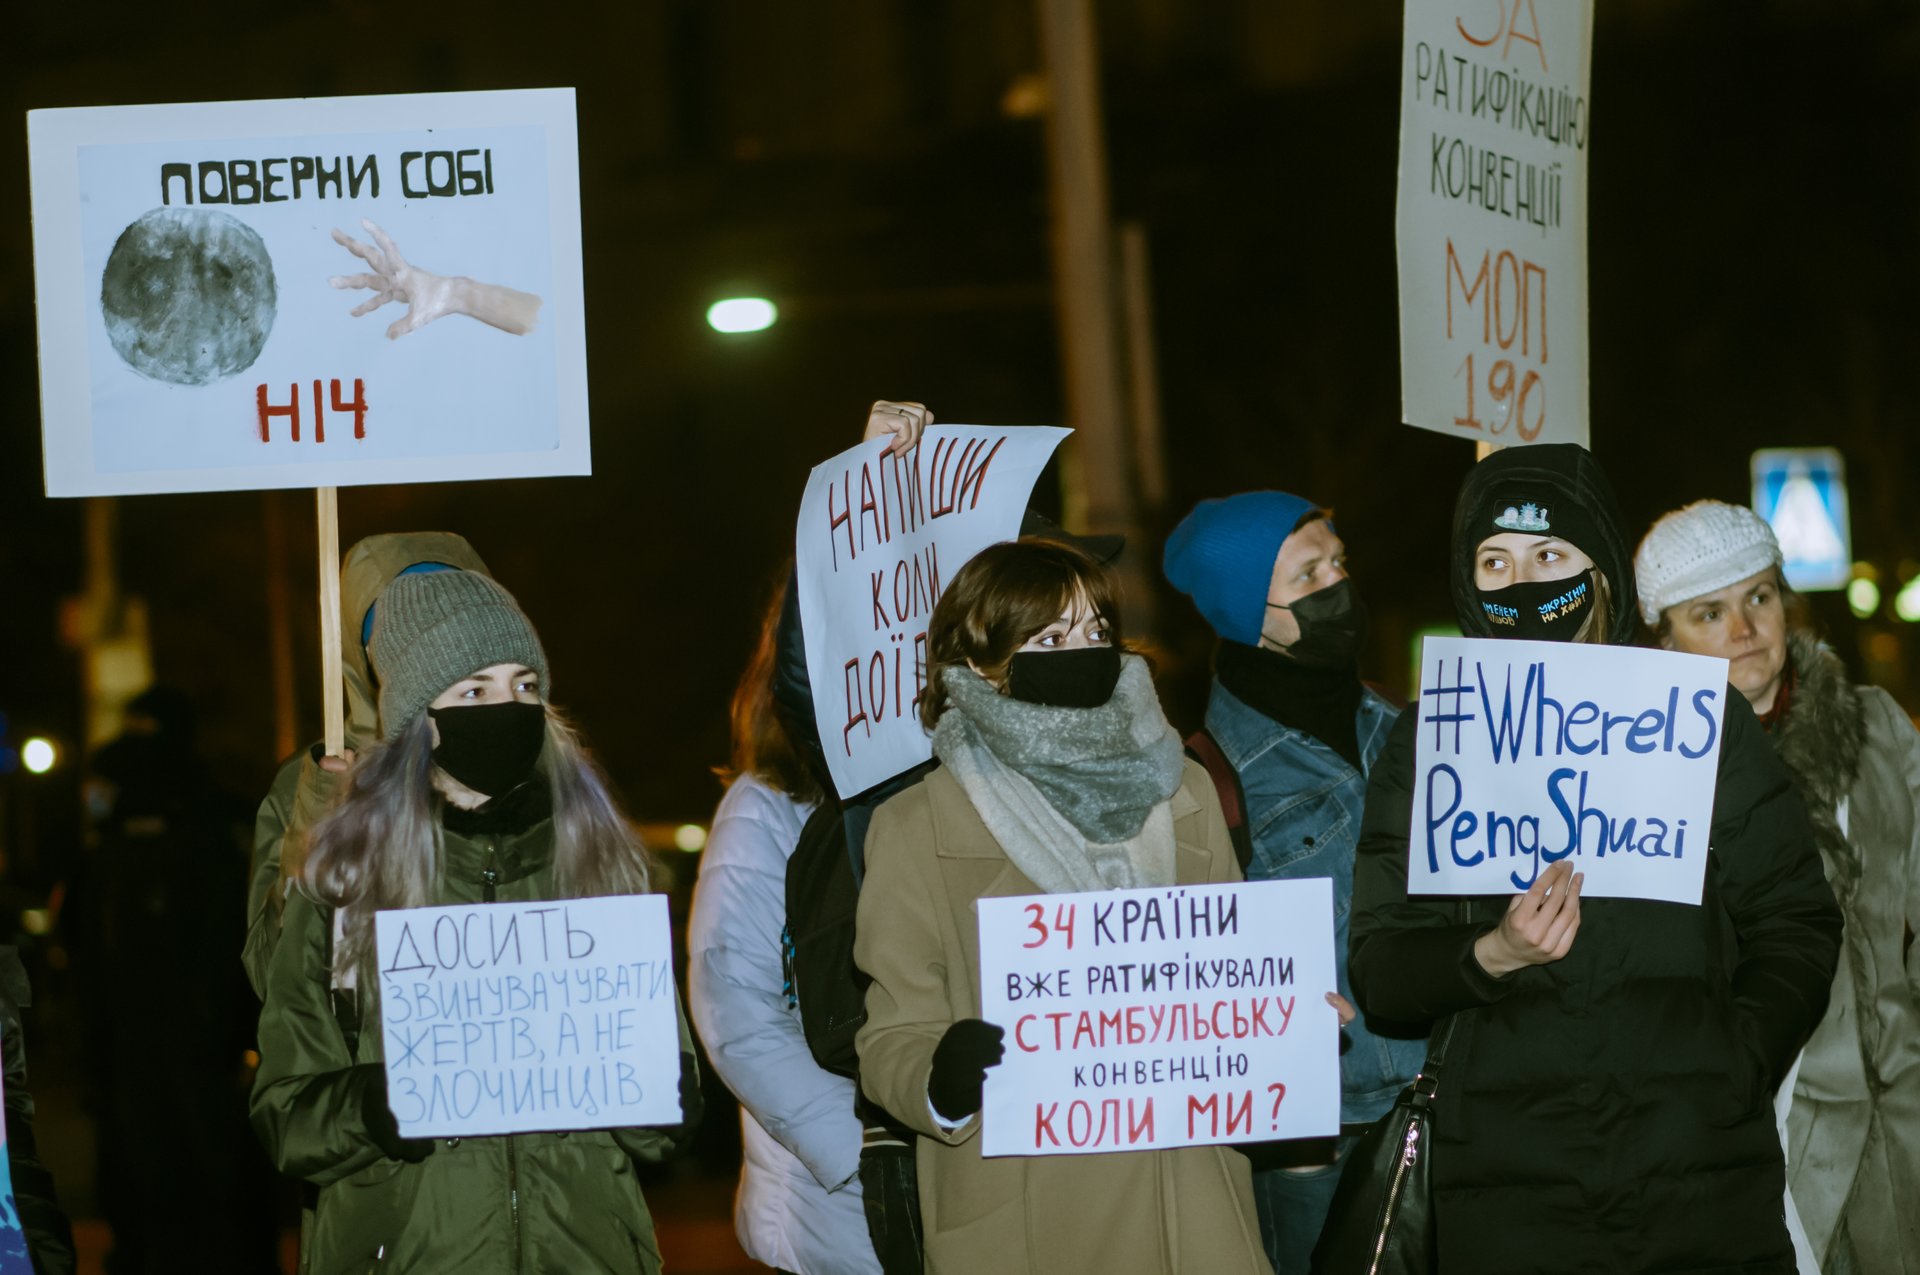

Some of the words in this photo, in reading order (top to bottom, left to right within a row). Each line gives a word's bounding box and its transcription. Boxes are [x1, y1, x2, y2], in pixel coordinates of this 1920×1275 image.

[1416, 41, 1586, 150] РАТИФІКАЦІЮ
[161, 154, 380, 205] ПОВЕРНИ
[401, 149, 494, 198] СОБІ
[1431, 132, 1562, 238] КОНВЕНЦІЇ
[1446, 237, 1547, 365] МОП
[257, 378, 368, 443] НІЧ
[1453, 353, 1545, 442] 190
[829, 436, 1007, 572] НАПИШИ
[872, 542, 941, 630] КОЛИ
[1541, 612, 1558, 623] НА
[1426, 763, 1687, 891] PengShuai
[382, 906, 595, 982] ДОСИТЬ
[1022, 903, 1076, 950] 34
[1094, 890, 1238, 946] КРАЇНИ
[387, 959, 668, 1023] ЗВИНУВАЧУВАТИ
[1006, 969, 1071, 1001] ВЖЕ
[1087, 952, 1295, 995] РАТИФІКУВАЛИ
[389, 1017, 545, 1069] ЖЕРТВ,
[558, 1012, 580, 1056] А
[596, 1008, 636, 1052] НЕ
[1015, 995, 1295, 1052] СТАМБУЛЬСЬКУ
[396, 1056, 643, 1123] ЗЛОЧИНЦІВ
[1074, 1045, 1248, 1087] КОНВЕНЦІЮ
[1035, 1097, 1154, 1148] КОЛИ
